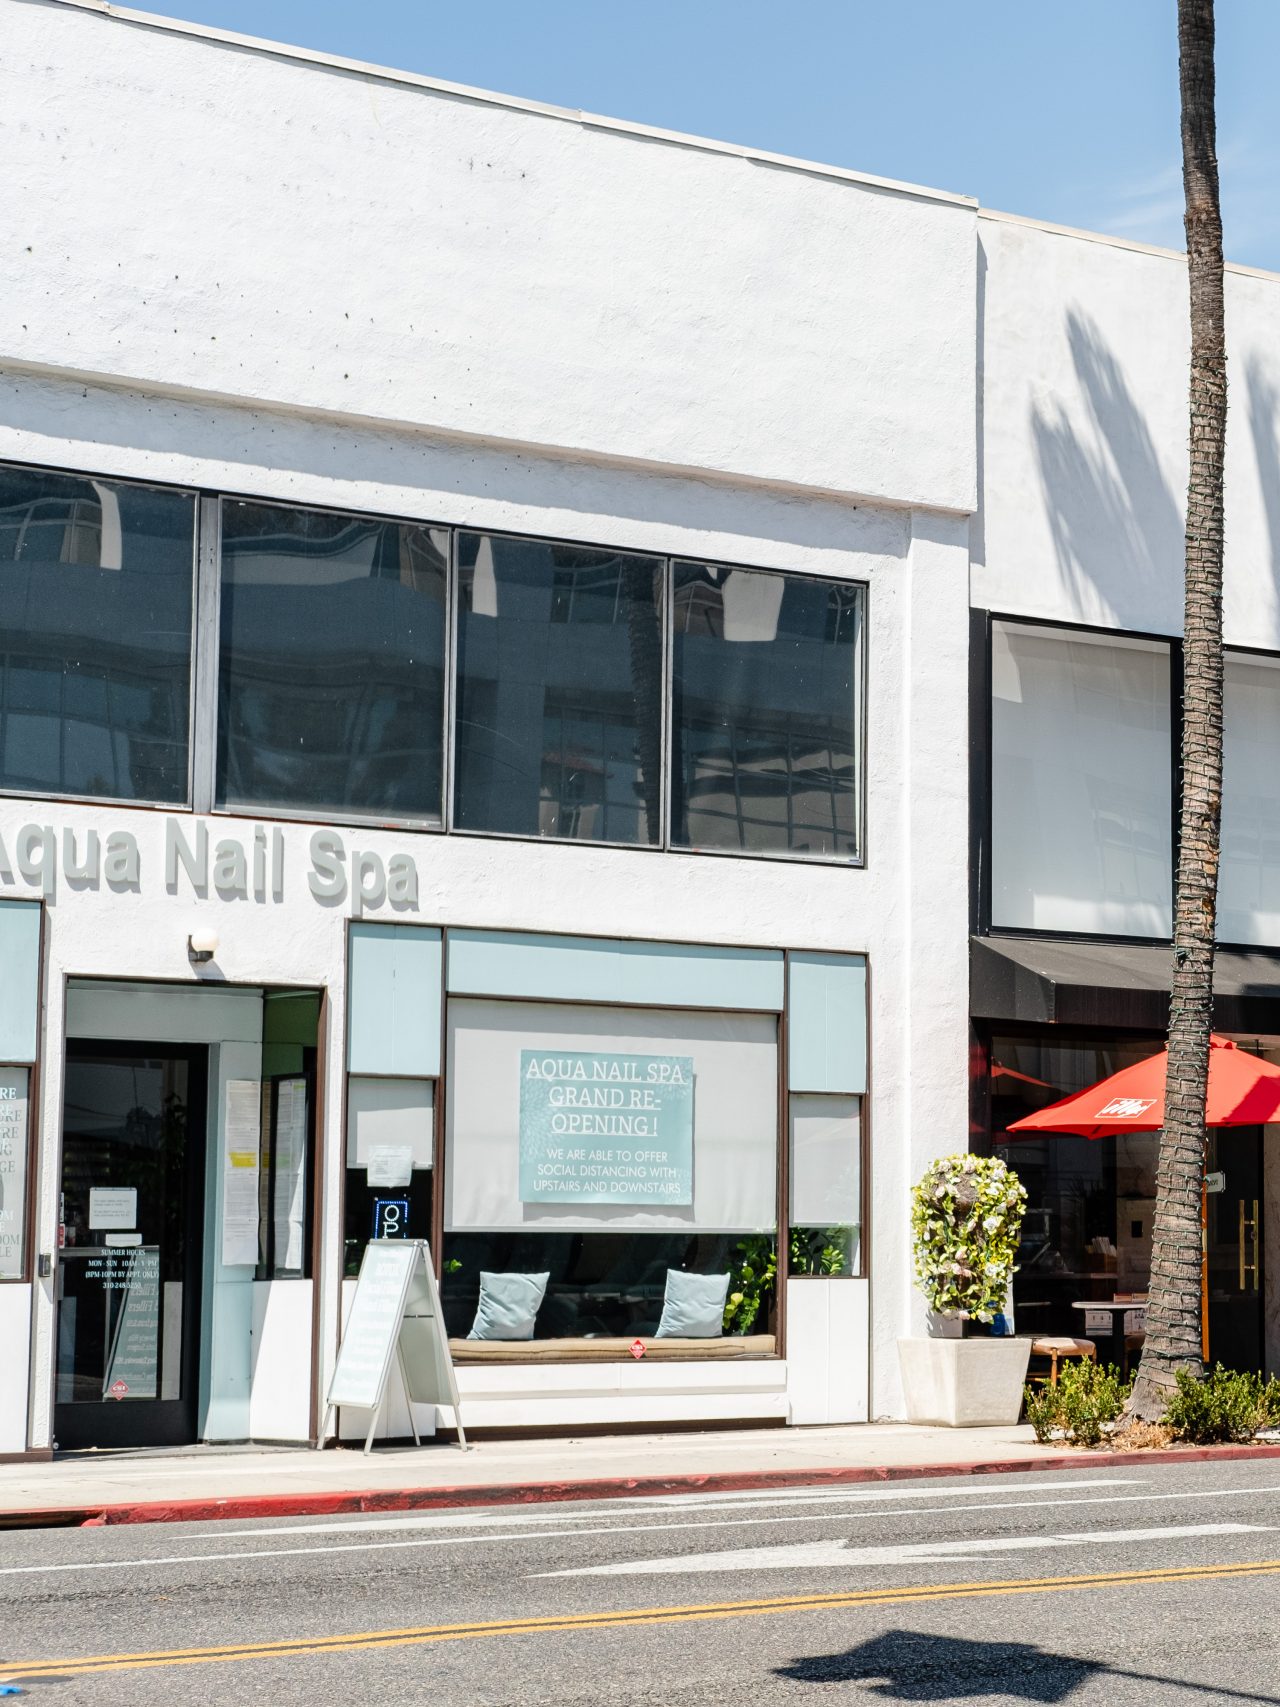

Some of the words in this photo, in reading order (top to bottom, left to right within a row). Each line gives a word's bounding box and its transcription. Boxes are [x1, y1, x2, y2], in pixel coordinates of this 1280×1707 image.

[164, 817, 282, 892] Nail
[308, 829, 418, 918] Spa
[526, 1058, 586, 1081] AQUA
[592, 1061, 641, 1082] NAIL
[548, 1086, 624, 1108] GRAND
[629, 1089, 661, 1110] RE-
[546, 1148, 563, 1161] WE
[567, 1149, 586, 1161] ARE
[589, 1149, 613, 1161] ABLE
[616, 1150, 631, 1162] TO
[634, 1151, 668, 1163] OFFER
[537, 1163, 577, 1176] SOCIAL
[580, 1165, 647, 1178] DISTANCING
[649, 1167, 676, 1178] WITH
[533, 1179, 581, 1192] UPSTAIRS
[583, 1181, 607, 1193] AND
[610, 1181, 681, 1194] DOWNSTAIRS
[383, 1204, 400, 1239] OP
